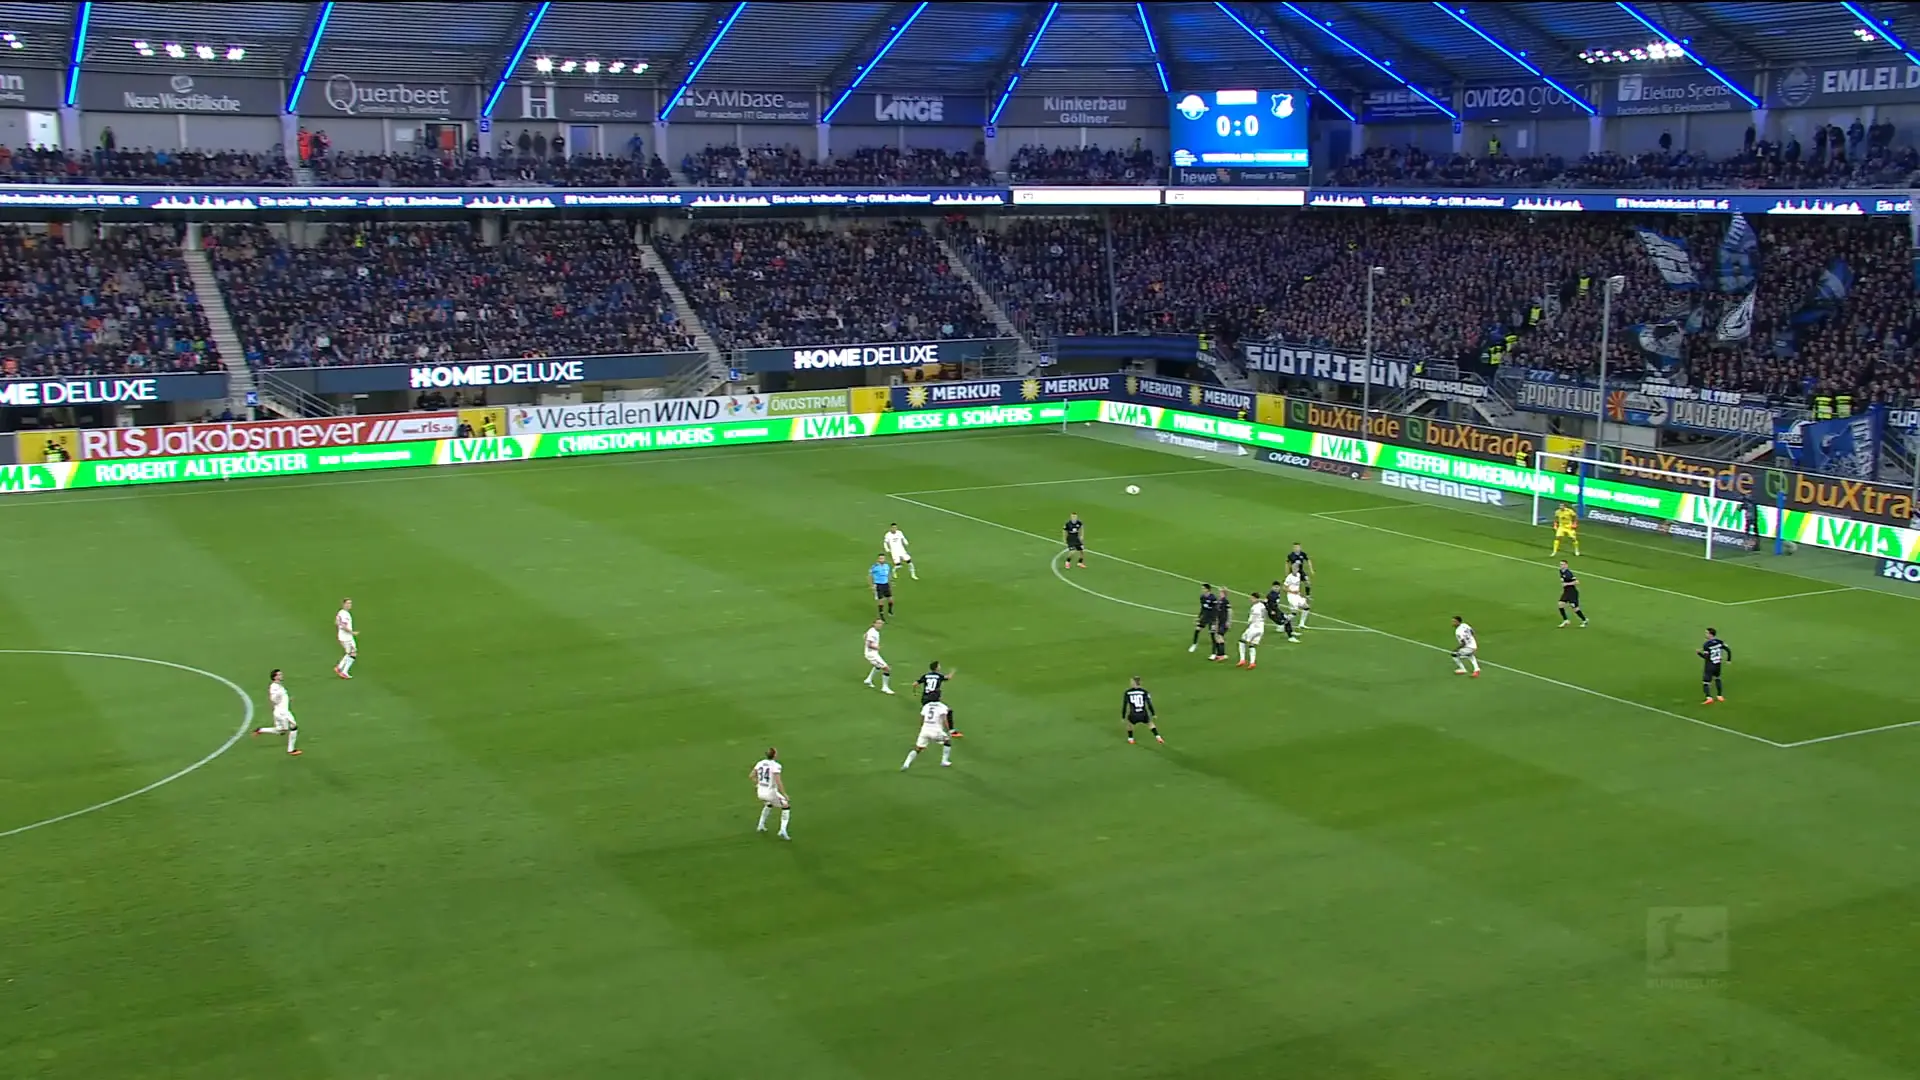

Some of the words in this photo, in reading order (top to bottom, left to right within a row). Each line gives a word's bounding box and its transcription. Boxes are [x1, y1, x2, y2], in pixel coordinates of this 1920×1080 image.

[124, 92, 159, 109] Neue
[160, 93, 241, 111] Westfälische
[325, 74, 450, 115] Querbeet
[584, 90, 619, 104] HÖBER
[695, 88, 784, 109] SAMbase
[1464, 86, 1525, 108] avitea
[1643, 85, 1684, 100] Elektro
[875, 96, 944, 121] LANGE
[1044, 97, 1127, 112] Klinkerbau
[1060, 113, 1109, 124] Göllner
[1216, 115, 1259, 137] 0:0
[1180, 168, 1217, 183] hewe
[794, 349, 861, 369] HOME
[863, 345, 938, 365] DELUXE
[1246, 345, 1408, 389] SÜDTRIBÜN
[411, 364, 492, 390] HOME
[494, 360, 584, 385] DELUXE
[1044, 377, 1110, 394] MERKUR
[43, 379, 157, 404] DELUXE
[932, 383, 1001, 401] MERKUR
[1140, 379, 1183, 399] MERKUR
[1204, 389, 1251, 410] MERKUR
[1517, 383, 1601, 415] SPORTCLUB
[804, 415, 846, 439] LVM
[898, 413, 945, 430] HESSE
[962, 405, 1033, 426] SCHÄFERS
[1307, 402, 1400, 438] buXtrade
[84, 428, 147, 459] RLS
[148, 420, 367, 457] Jakobsmeyer
[451, 437, 502, 463] LVM
[558, 431, 651, 453] CHRISTOPH
[656, 427, 715, 446] MOERS
[1321, 434, 1351, 461] LVM
[96, 461, 177, 483] ROBERT
[184, 451, 308, 478] ALTEKÖSTER
[1269, 452, 1310, 467] avitea
[1311, 459, 1350, 474] group
[1396, 451, 1449, 475] STEFFEN
[1381, 469, 1503, 506] BREMER
[1588, 509, 1629, 525] Eisenbach
[1629, 516, 1658, 530] Tresore
[1668, 524, 1708, 539] Eisenbac
[1816, 517, 1873, 553] LVM
[1129, 694, 1144, 708] 40
[927, 708, 935, 720] 5
[758, 767, 770, 783] 34
